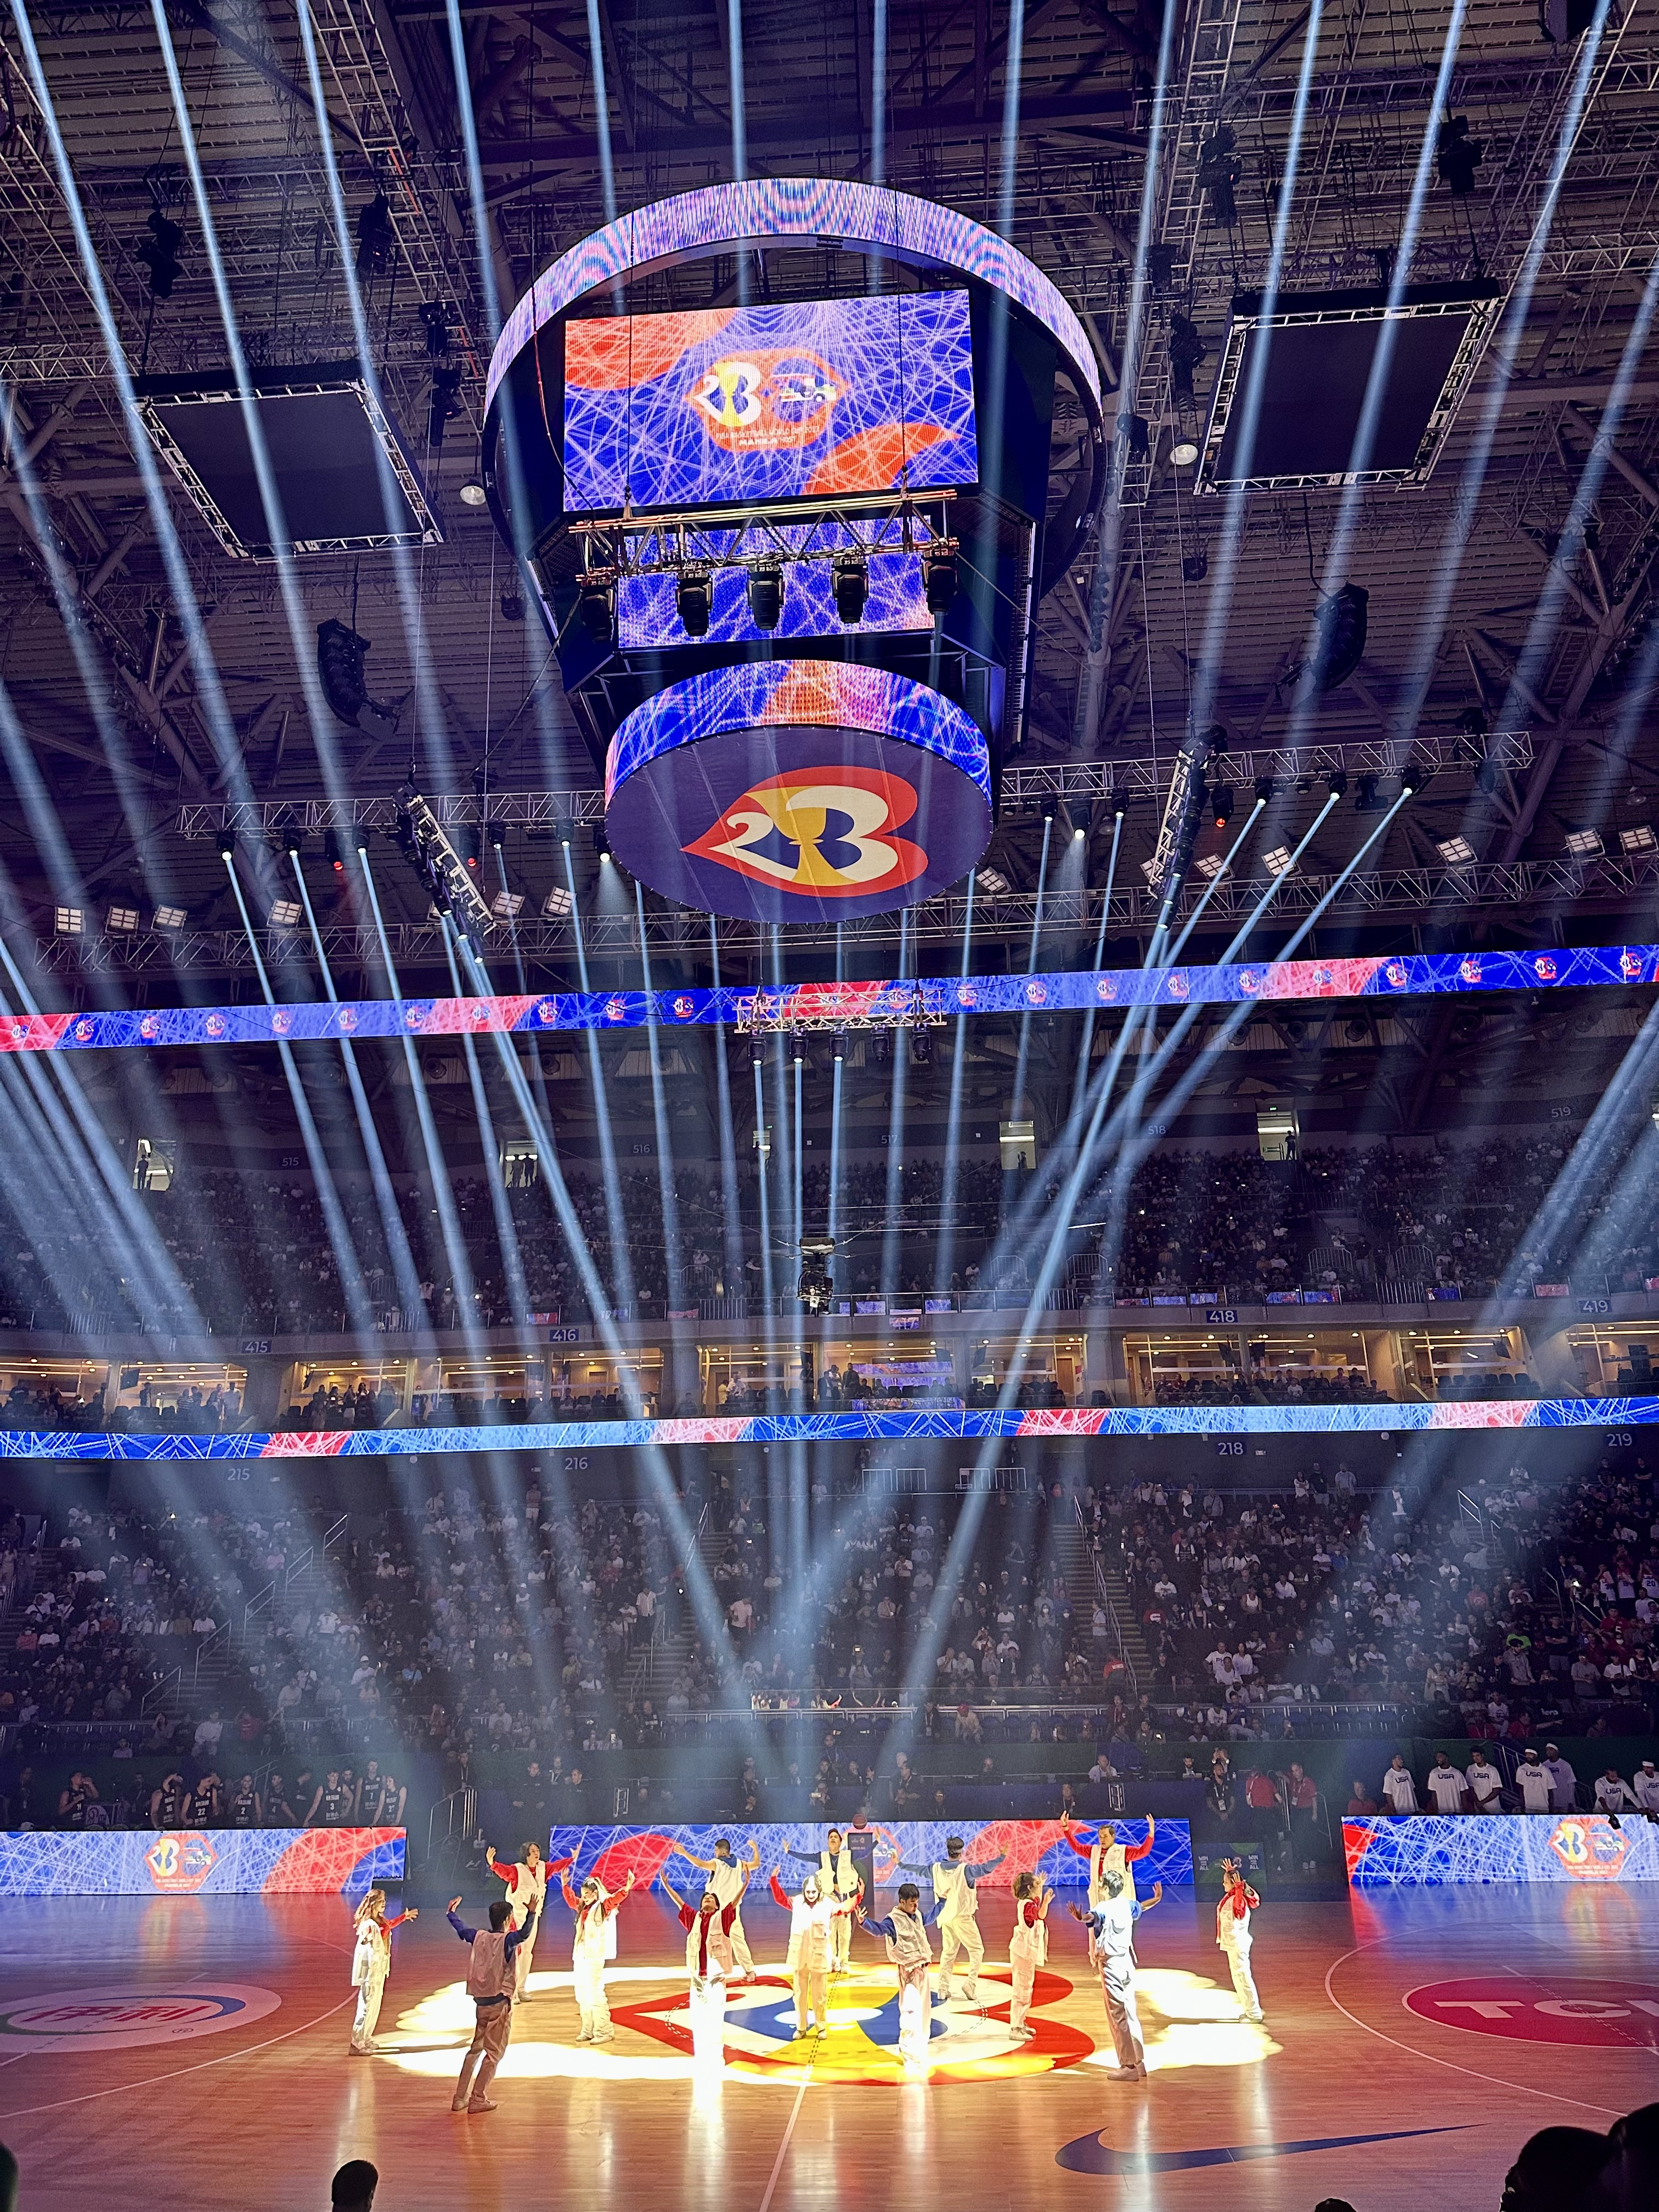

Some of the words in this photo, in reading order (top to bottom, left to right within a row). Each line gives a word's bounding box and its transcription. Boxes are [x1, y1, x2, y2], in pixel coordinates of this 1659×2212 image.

[1550, 1106, 1571, 1118] 519
[1148, 1125, 1166, 1135] 518
[881, 1134, 898, 1144] 517
[633, 1143, 650, 1153] 516
[281, 1156, 300, 1166] 515
[1582, 1300, 1609, 1313] 419
[1209, 1310, 1235, 1323] 418
[552, 1329, 577, 1341] 416
[245, 1341, 269, 1353] 415
[1606, 1433, 1633, 1447] 219
[1218, 1442, 1243, 1455] 218
[564, 1457, 588, 1470] 216
[228, 1468, 250, 1481] 215
[1615, 1626, 1622, 1634] 5
[198, 1808, 206, 1816] 22
[241, 1807, 246, 1815] 2
[330, 1802, 335, 1810] 3
[21, 2006, 212, 2023] 伊利
